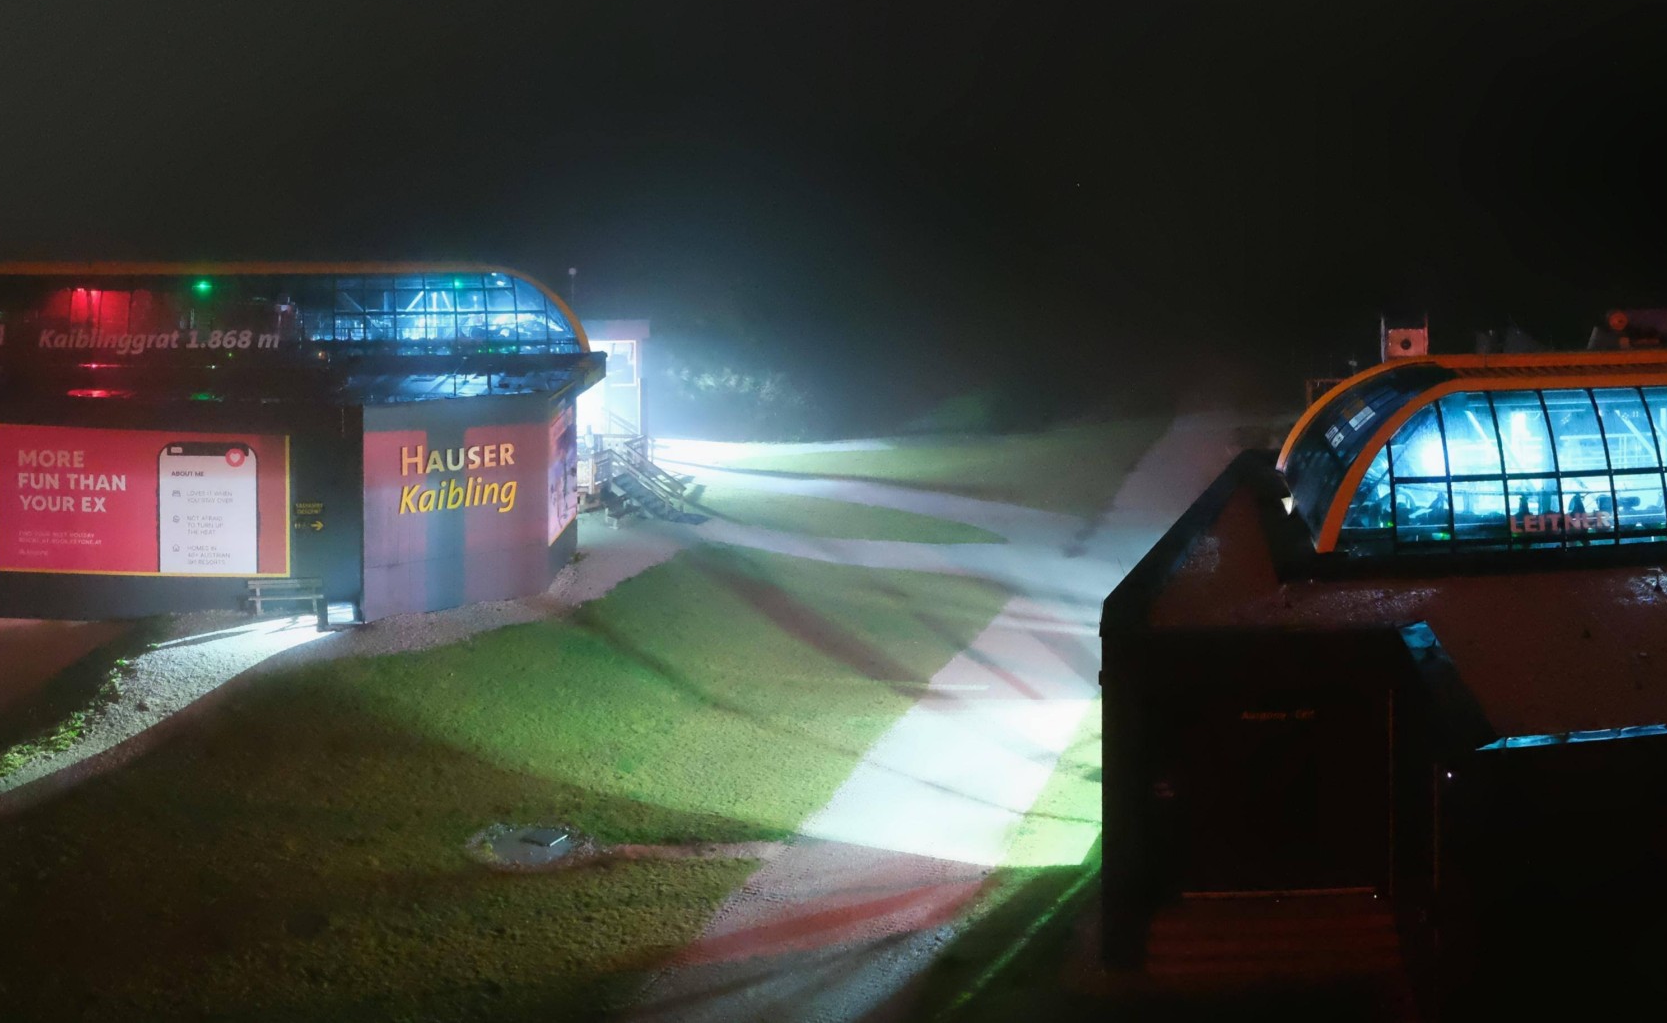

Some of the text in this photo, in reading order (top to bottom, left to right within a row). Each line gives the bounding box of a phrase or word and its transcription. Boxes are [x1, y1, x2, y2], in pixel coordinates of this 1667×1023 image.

[38, 328, 280, 354] Kaiblinggrat 1.868 m
[18, 449, 85, 468] MORE
[401, 443, 515, 476] HAUSER
[18, 473, 127, 491] FUN THAN
[20, 495, 107, 513] YOUR EX
[399, 477, 518, 514] Kaibling
[1510, 511, 1611, 533] LEITNER
